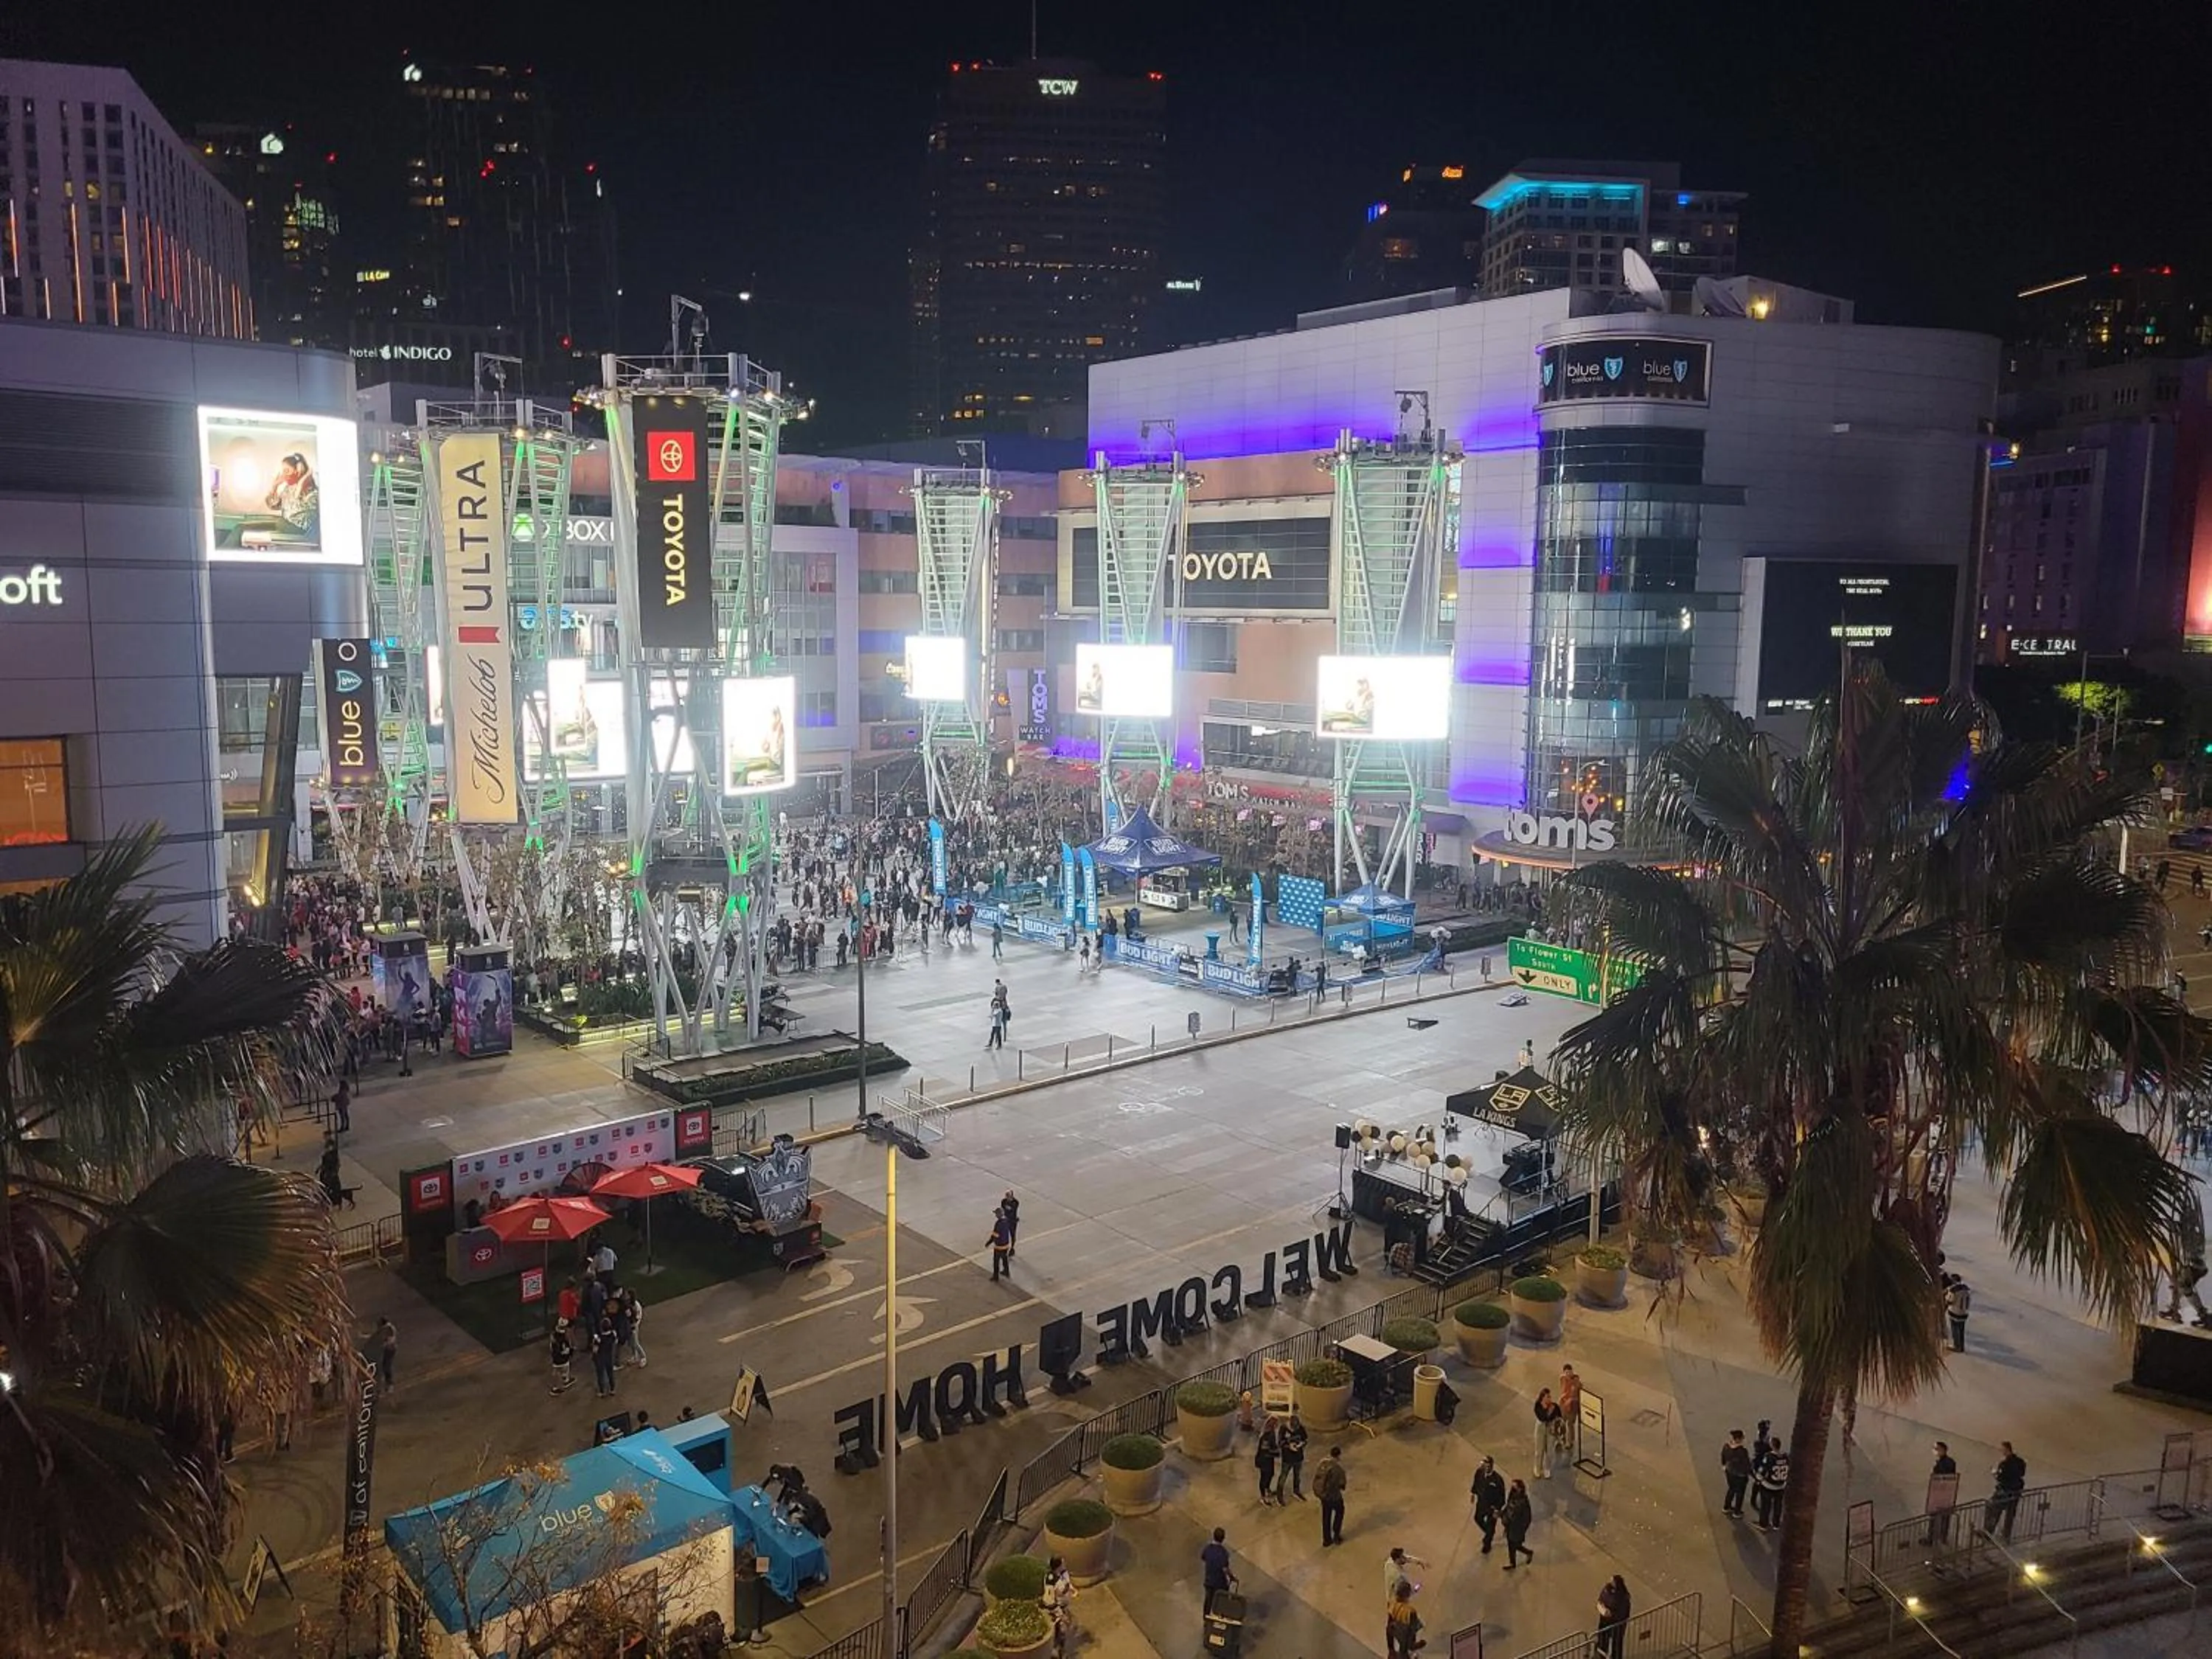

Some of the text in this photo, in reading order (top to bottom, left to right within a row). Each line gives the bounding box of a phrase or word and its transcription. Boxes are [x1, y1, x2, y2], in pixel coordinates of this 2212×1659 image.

[1038, 79, 1079, 95] TCW
[349, 346, 452, 361] hotel INDIGO
[1568, 362, 1600, 378] blue
[1644, 361, 1671, 375] blue
[456, 459, 493, 611] ULTRA
[663, 493, 686, 606] TOYOTA
[1845, 625, 1874, 636] THANK
[1874, 625, 1893, 636] YOU
[1032, 668, 1048, 723] TOMS
[337, 700, 364, 766] blue
[467, 653, 505, 804] Michelob
[1207, 781, 1249, 801] TOMS
[1503, 810, 1615, 851] toms
[1119, 941, 1172, 966] BUD LIGHT
[1516, 943, 1572, 963] To Flower St
[1207, 964, 1232, 981] BUD
[1543, 975, 1571, 990] ONLY
[1498, 1086, 1526, 1102] LA
[1473, 1107, 1517, 1128] LA KINGS
[351, 1480, 366, 1503] of
[539, 1504, 592, 1533] blue
